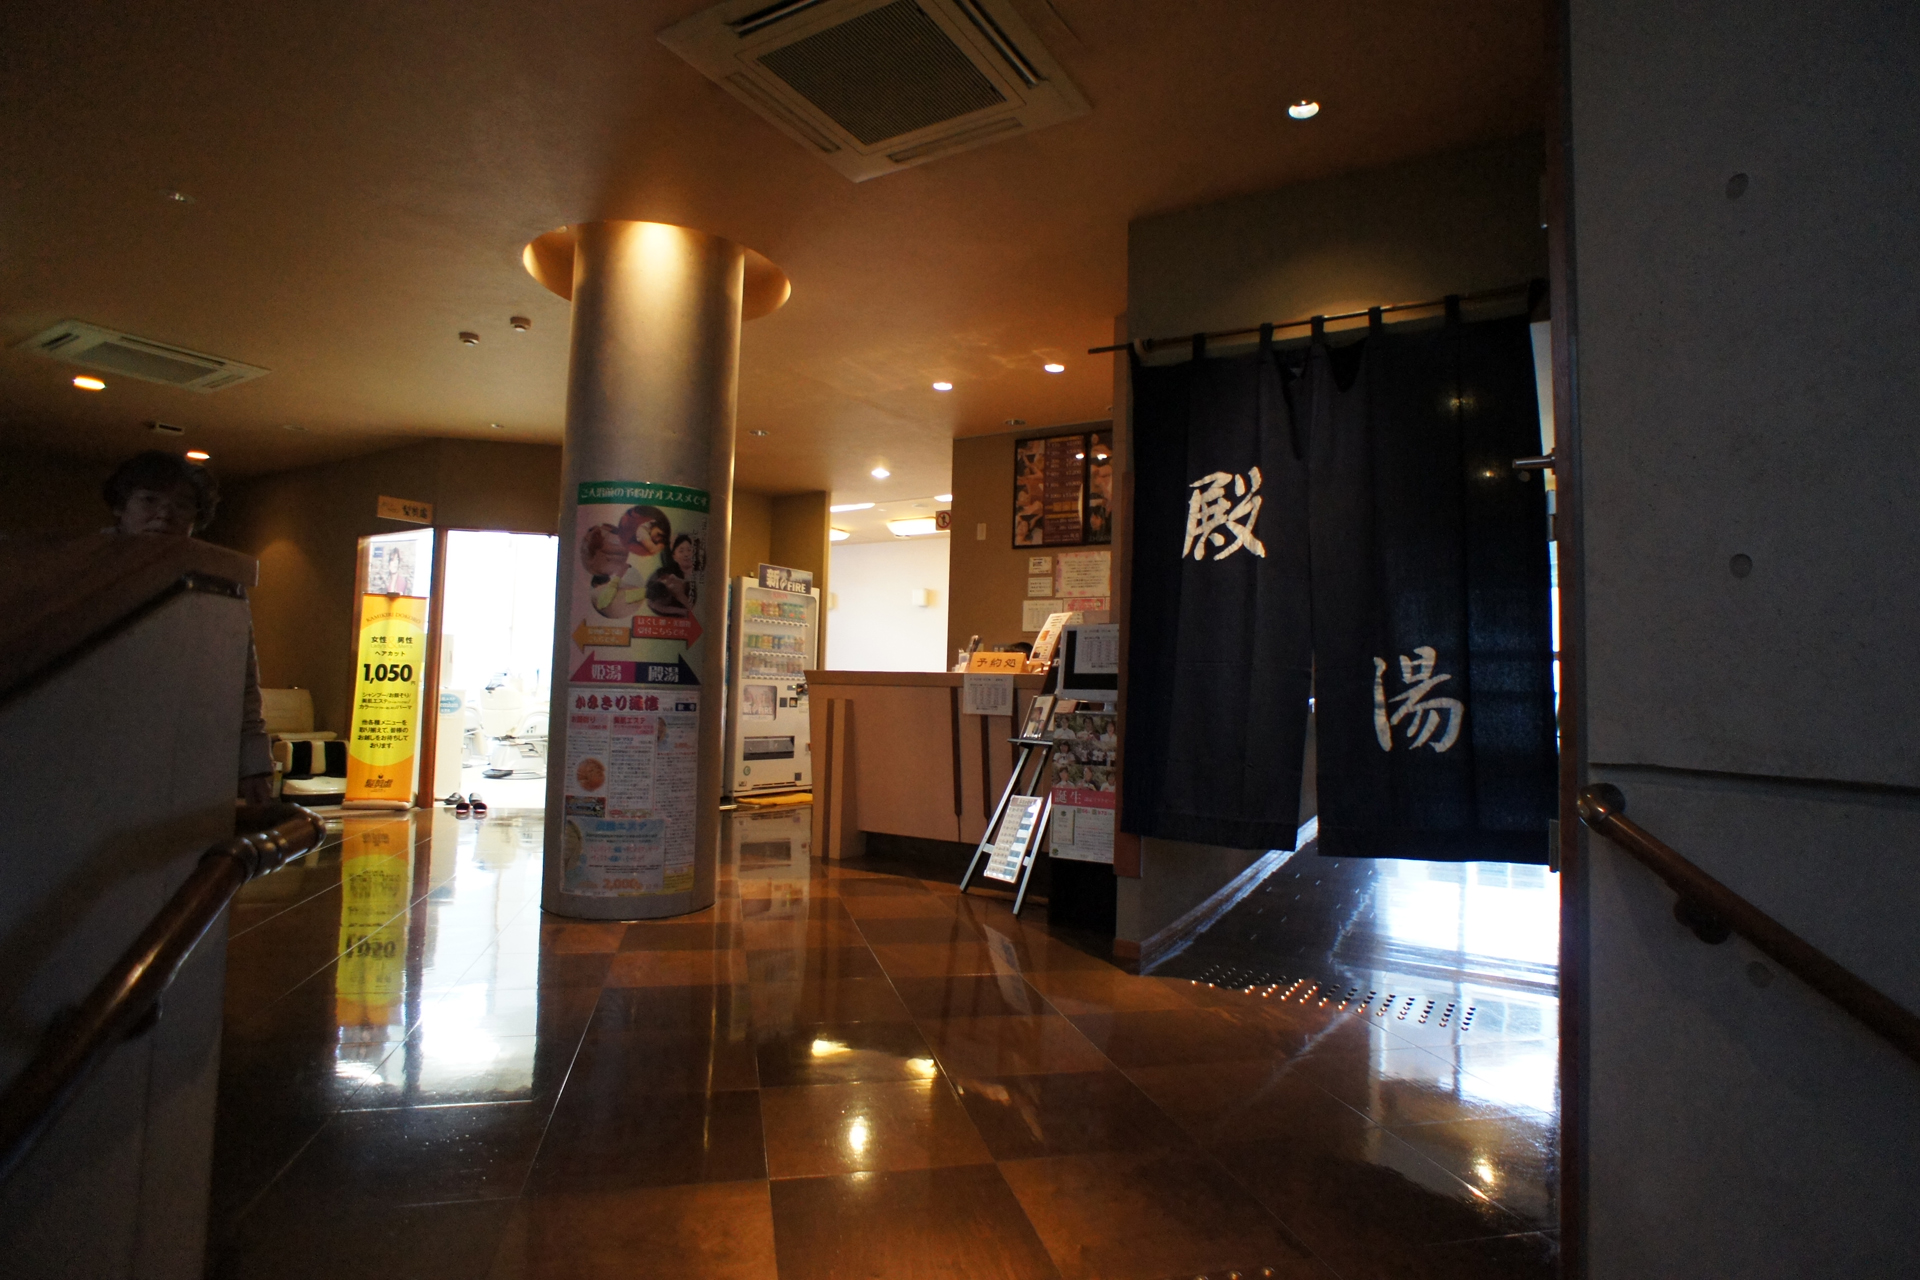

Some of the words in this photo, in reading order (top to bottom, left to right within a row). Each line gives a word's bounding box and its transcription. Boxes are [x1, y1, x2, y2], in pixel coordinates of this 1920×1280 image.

[766, 568, 780, 589] 新
[787, 581, 807, 593] FIRE
[1182, 466, 1266, 561] 殿
[1373, 645, 1464, 752] 湯
[366, 612, 394, 622] KAMIKIRI
[395, 612, 421, 624] DOKORO
[397, 636, 413, 644] 男性
[976, 657, 1016, 668] 予約処
[592, 664, 622, 680] 姫湯
[648, 665, 679, 682] 殿湯
[1054, 789, 1081, 804] 誕生
